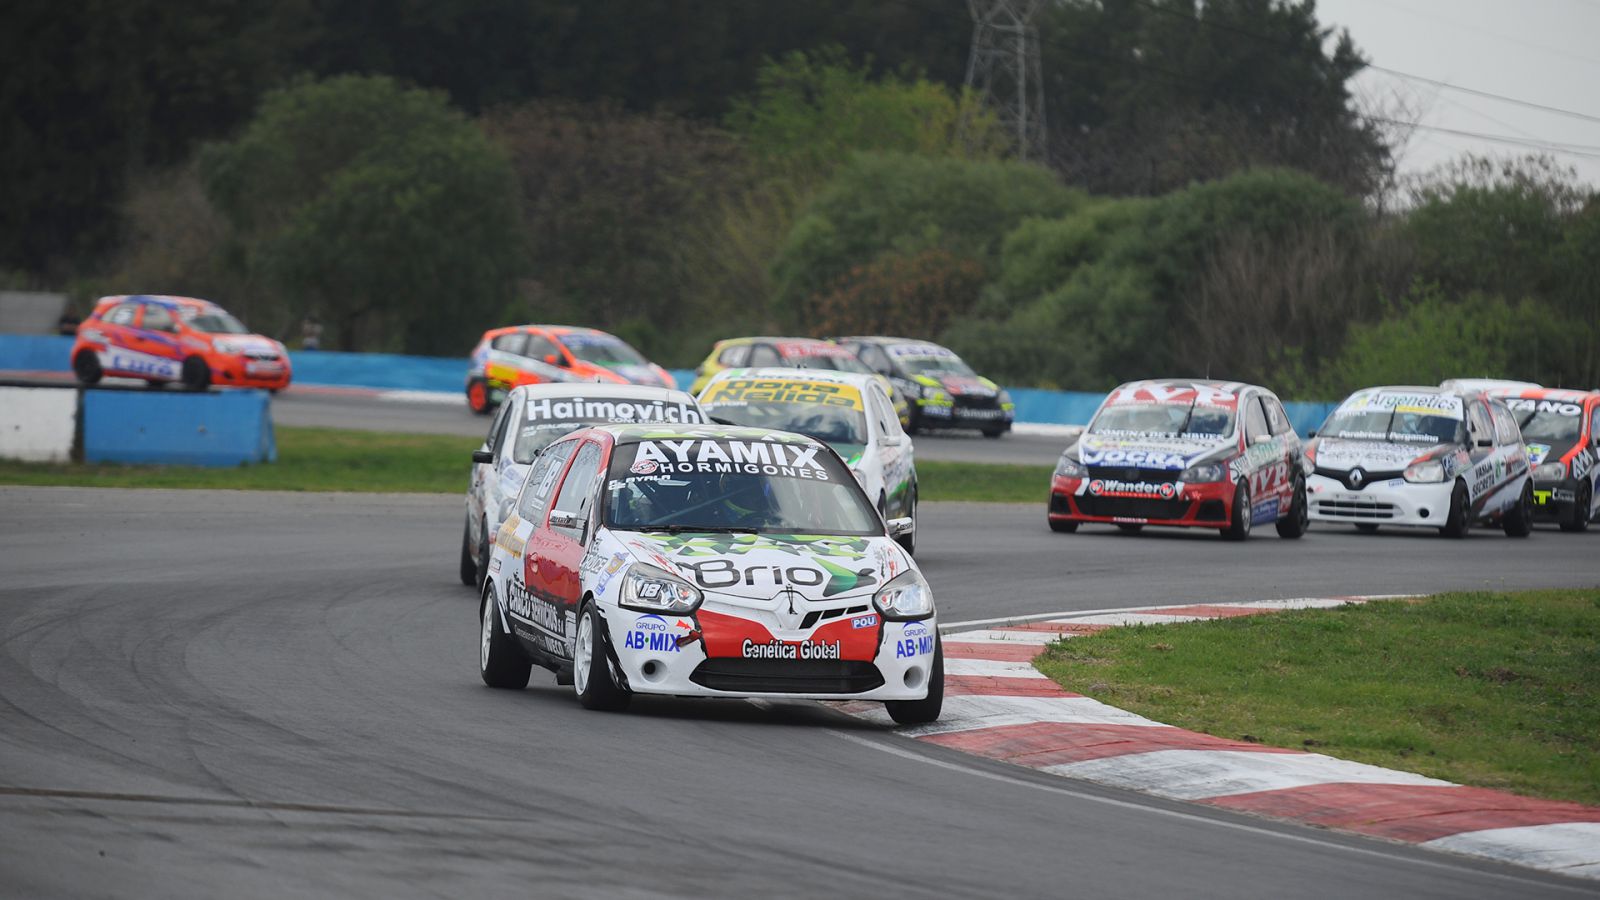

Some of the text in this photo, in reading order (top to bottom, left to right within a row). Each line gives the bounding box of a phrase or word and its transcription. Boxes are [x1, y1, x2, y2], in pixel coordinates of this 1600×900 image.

[1368, 393, 1458, 411] Argenetics
[526, 397, 701, 425] Haimovich
[1389, 431, 1439, 443] Pergamino
[633, 439, 824, 471] AYAMIX
[658, 461, 829, 481] HORMIGONES
[1104, 479, 1160, 493] Wander
[695, 559, 824, 589] Brio
[639, 583, 661, 598] 18
[635, 622, 666, 632] GRUPO
[852, 616, 878, 628] POU
[904, 629, 928, 637] GRUPO
[742, 639, 841, 660] Genética Global
